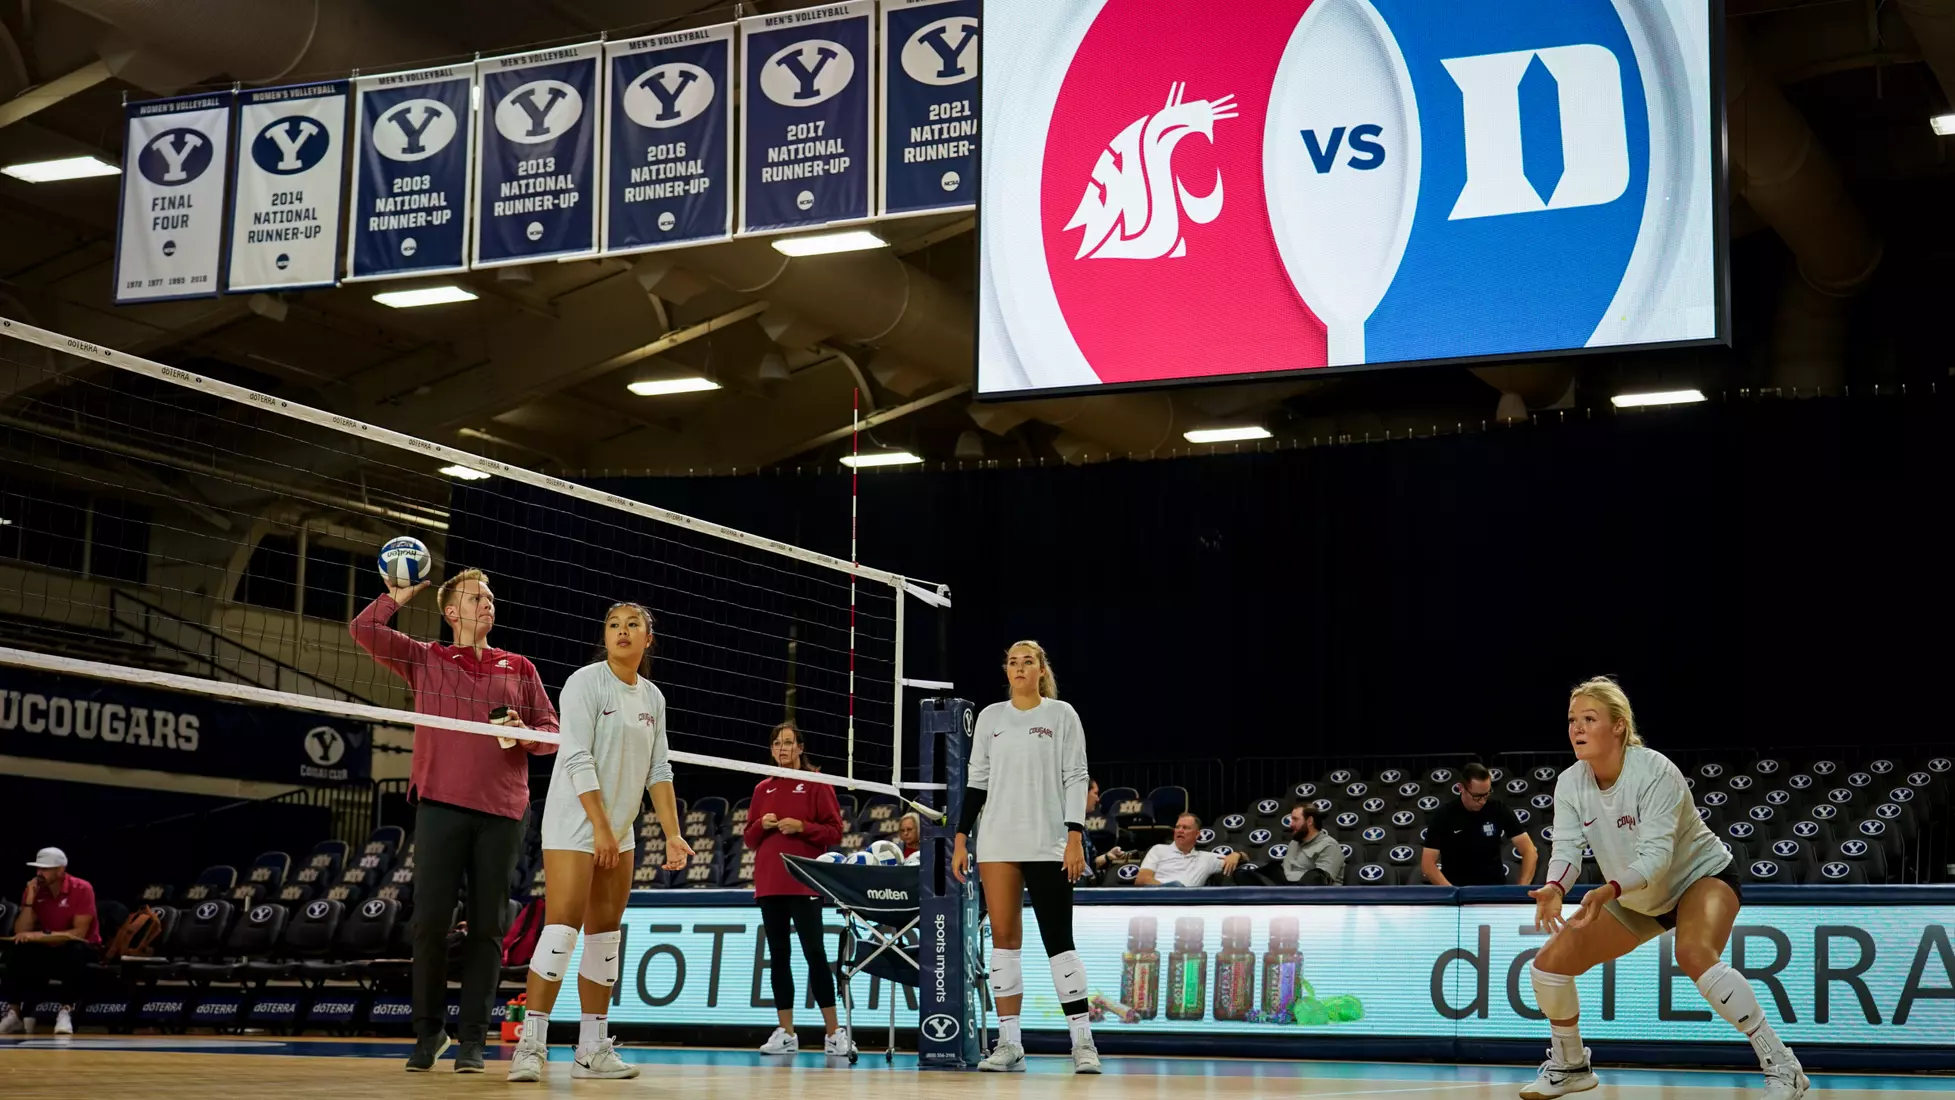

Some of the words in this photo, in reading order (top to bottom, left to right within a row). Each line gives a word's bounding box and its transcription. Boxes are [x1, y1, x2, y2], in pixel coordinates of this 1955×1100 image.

[764, 14, 794, 28] MEN'S
[796, 6, 850, 22] VOLLEYBALL
[628, 36, 656, 50] MEN'S
[658, 29, 710, 46] VOLLEYBALL
[500, 56, 528, 68] MEN'S
[528, 48, 578, 64] VOLLEYBALL
[917, 24, 978, 78] Y
[378, 74, 404, 85] MEN'S
[406, 68, 454, 82] VOLLEYBALL
[776, 46, 838, 100] Y
[252, 90, 288, 102] WOMEN'S
[290, 85, 336, 98] VOLLEYBALL
[639, 70, 699, 122] Y
[140, 103, 174, 115] WOMEN'S
[176, 98, 219, 111] VOLLEYBALL
[510, 87, 568, 136] Y
[928, 100, 972, 122] 2021
[387, 106, 443, 154] Y
[786, 120, 826, 142] 2017
[264, 121, 319, 170] Y
[646, 142, 686, 162] 2016
[768, 138, 845, 163] NATIONAL
[1299, 123, 1387, 174] VS
[152, 133, 203, 181] Y
[518, 157, 556, 176] 2013
[630, 159, 704, 184] NATIONAL
[761, 156, 850, 184] RUNNER-UP
[392, 175, 431, 194] 2003
[500, 174, 574, 198] NATIONAL
[624, 177, 710, 203] RUNNER-UP
[151, 195, 193, 212] FINAL
[271, 190, 304, 207] 2014
[375, 192, 447, 213] NATIONAL
[494, 192, 580, 217] RUNNER-UP
[152, 214, 189, 231] FOUR
[253, 208, 318, 225] NATIONAL
[368, 210, 452, 232] RUNNER-UP
[247, 225, 322, 244] RUNNER-UP
[1028, 726, 1054, 738] COUGARS
[866, 888, 908, 900] molten
[934, 914, 946, 954] sports
[934, 955, 946, 1003] imports
